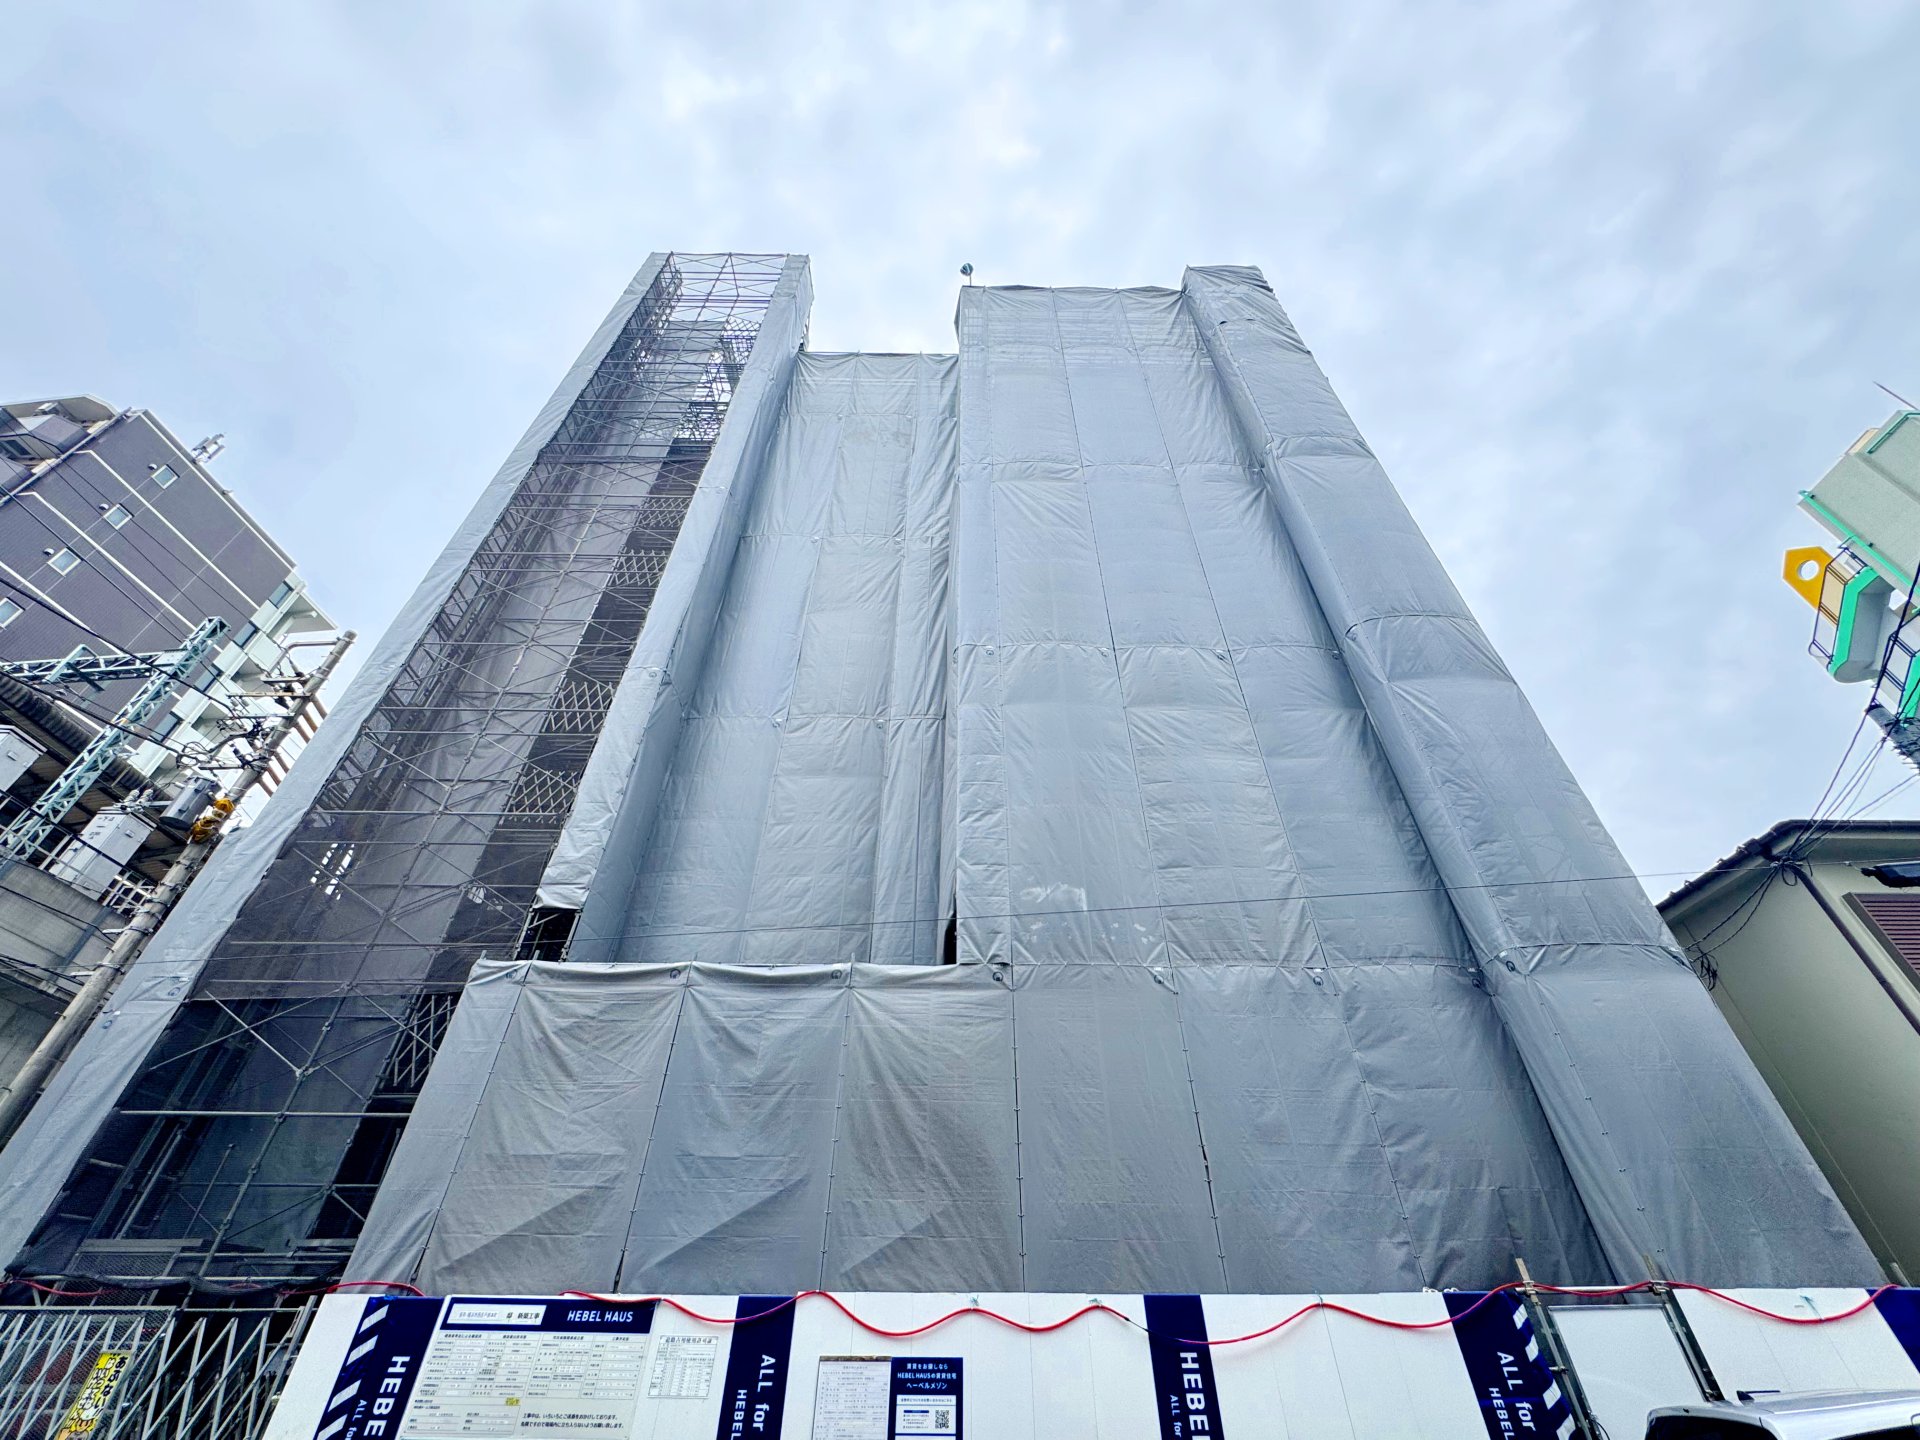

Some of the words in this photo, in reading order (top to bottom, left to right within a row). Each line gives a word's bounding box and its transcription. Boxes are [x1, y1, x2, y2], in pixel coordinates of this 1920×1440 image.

[567, 1310, 602, 1322] HEBEL
[604, 1311, 634, 1323] HAUS
[757, 1354, 776, 1392] ALL
[906, 1382, 948, 1390] ヘーベルメゾン
[1169, 1394, 1181, 1416] ALL
[1179, 1352, 1211, 1440] HEBE
[1497, 1351, 1524, 1391] ALL
[1515, 1401, 1537, 1431] for
[352, 1399, 367, 1421] ALL
[731, 1389, 748, 1440] HEBEL
[753, 1403, 770, 1432] for
[1488, 1387, 1515, 1440] HEBEL
[1173, 1421, 1182, 1438] for
